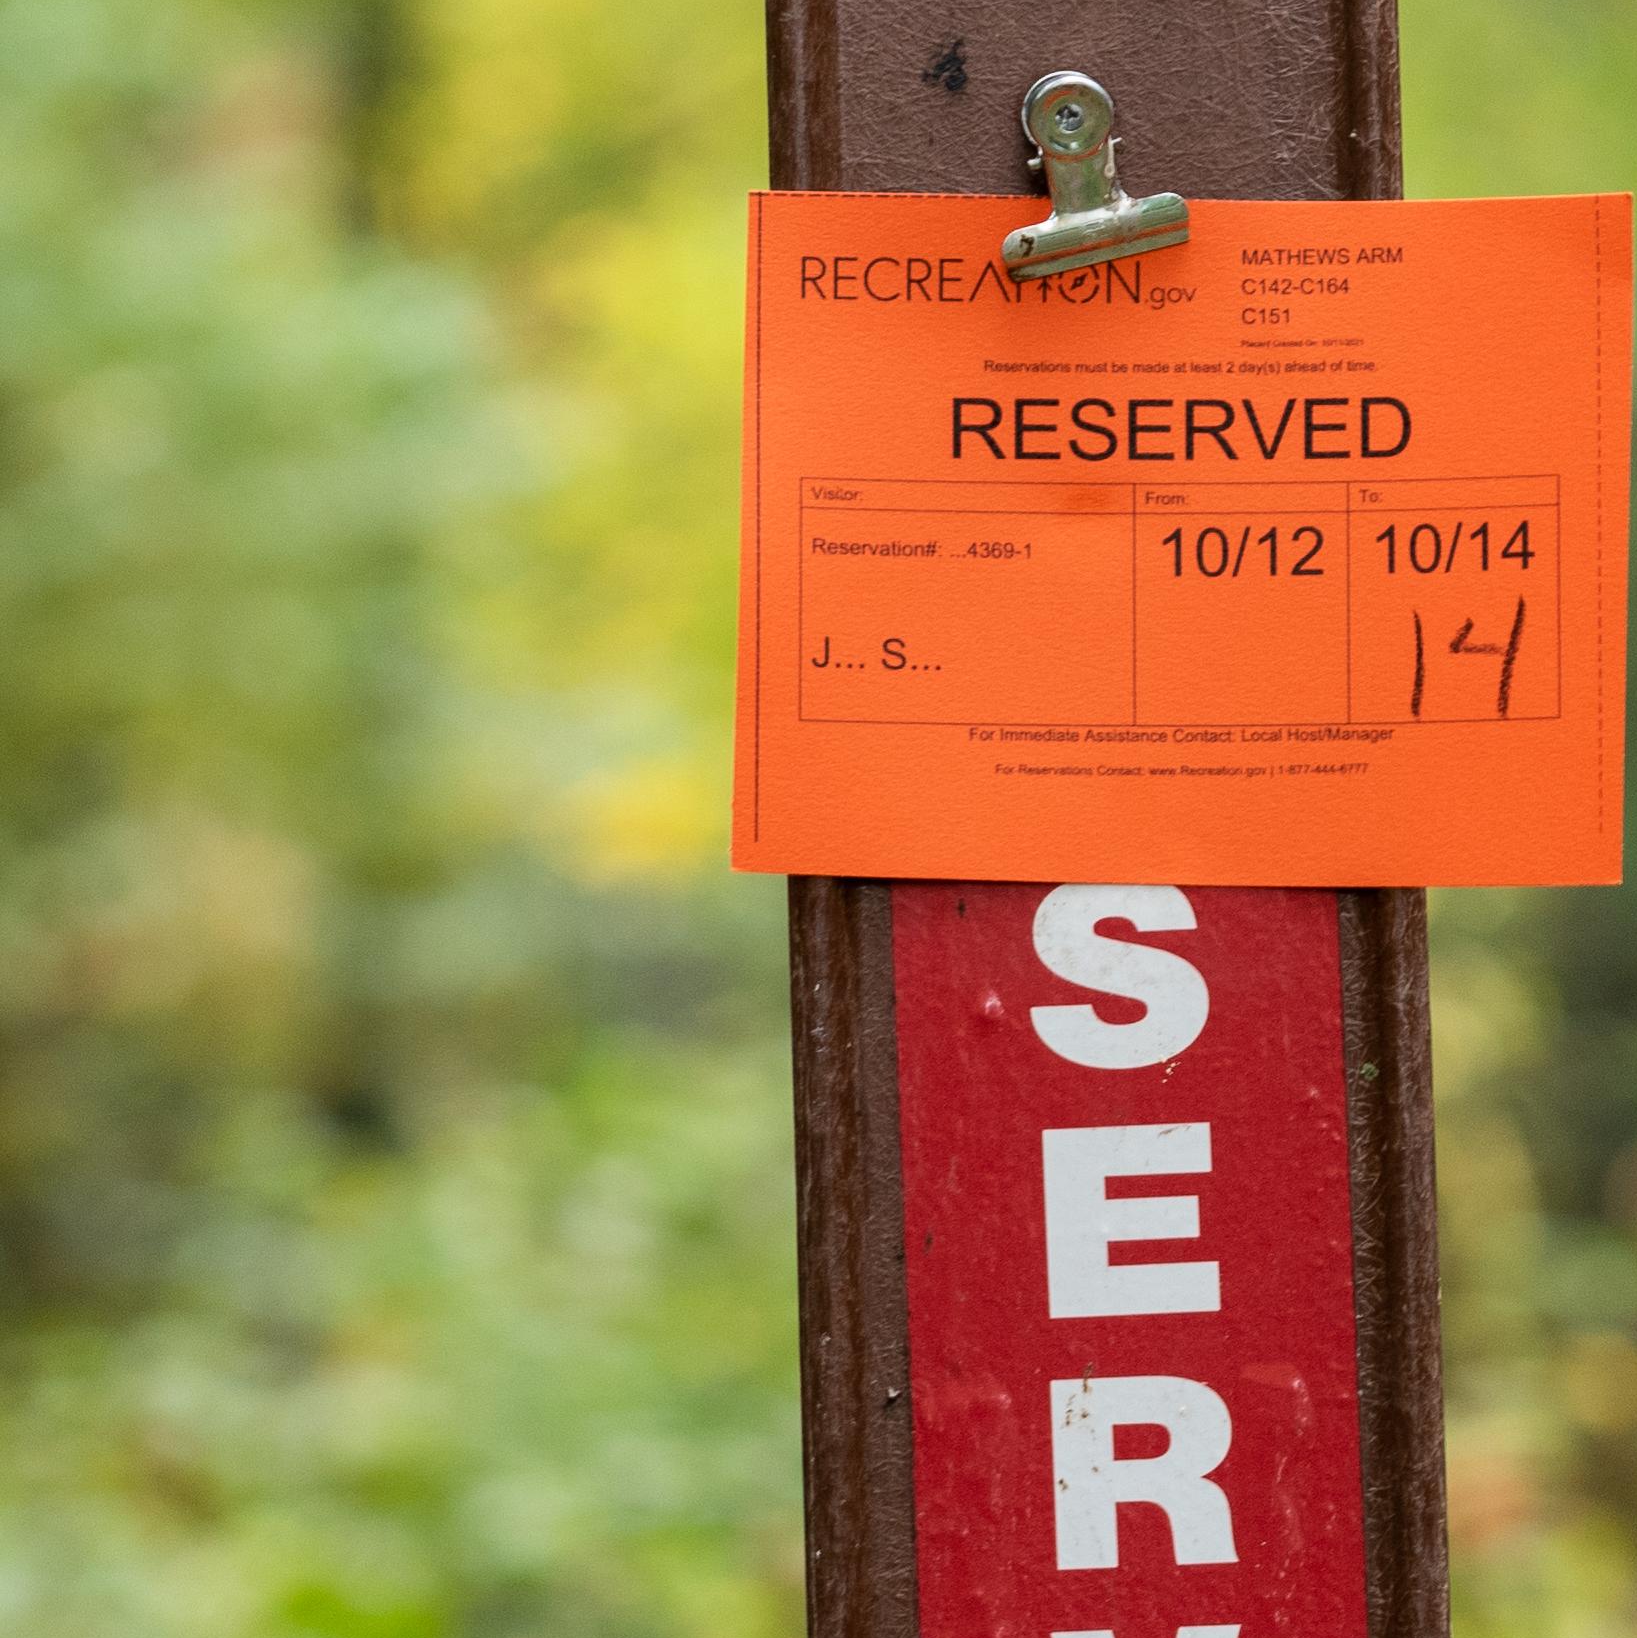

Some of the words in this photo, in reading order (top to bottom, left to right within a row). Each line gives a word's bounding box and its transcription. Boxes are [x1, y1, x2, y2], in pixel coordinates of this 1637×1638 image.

[1241, 248, 1350, 265] MATHEWS
[1356, 247, 1404, 263] ARM
[1241, 277, 1350, 295] C142-C164
[1241, 307, 1291, 325] C151
[983, 360, 1071, 373] Reservations
[1075, 362, 1108, 373] must
[1111, 362, 1128, 373] be
[1132, 362, 1169, 373] made
[1173, 362, 1187, 373] at
[1190, 362, 1222, 373] least
[1225, 362, 1235, 373] 2
[1238, 361, 1281, 376] day(s)
[1284, 360, 1326, 373] ahead
[1330, 360, 1344, 372] of
[952, 396, 1412, 461] RESERVED
[810, 486, 864, 502] Visitor:
[1144, 490, 1189, 506] From:
[1359, 488, 1384, 503] To:
[811, 537, 944, 558] Reservation#:
[1162, 525, 1325, 577] 10/12
[1375, 520, 1536, 574] 10/14
[811, 635, 866, 669] J...
[881, 637, 942, 670] S...
[1410, 594, 1527, 718] 14
[968, 727, 996, 741] For
[1000, 728, 1080, 743] Immediate
[1084, 728, 1168, 743] Assistance
[1241, 728, 1283, 742] Local
[1287, 726, 1395, 744] Host/Manager
[994, 763, 1014, 775] For
[1018, 764, 1095, 776] Reservations
